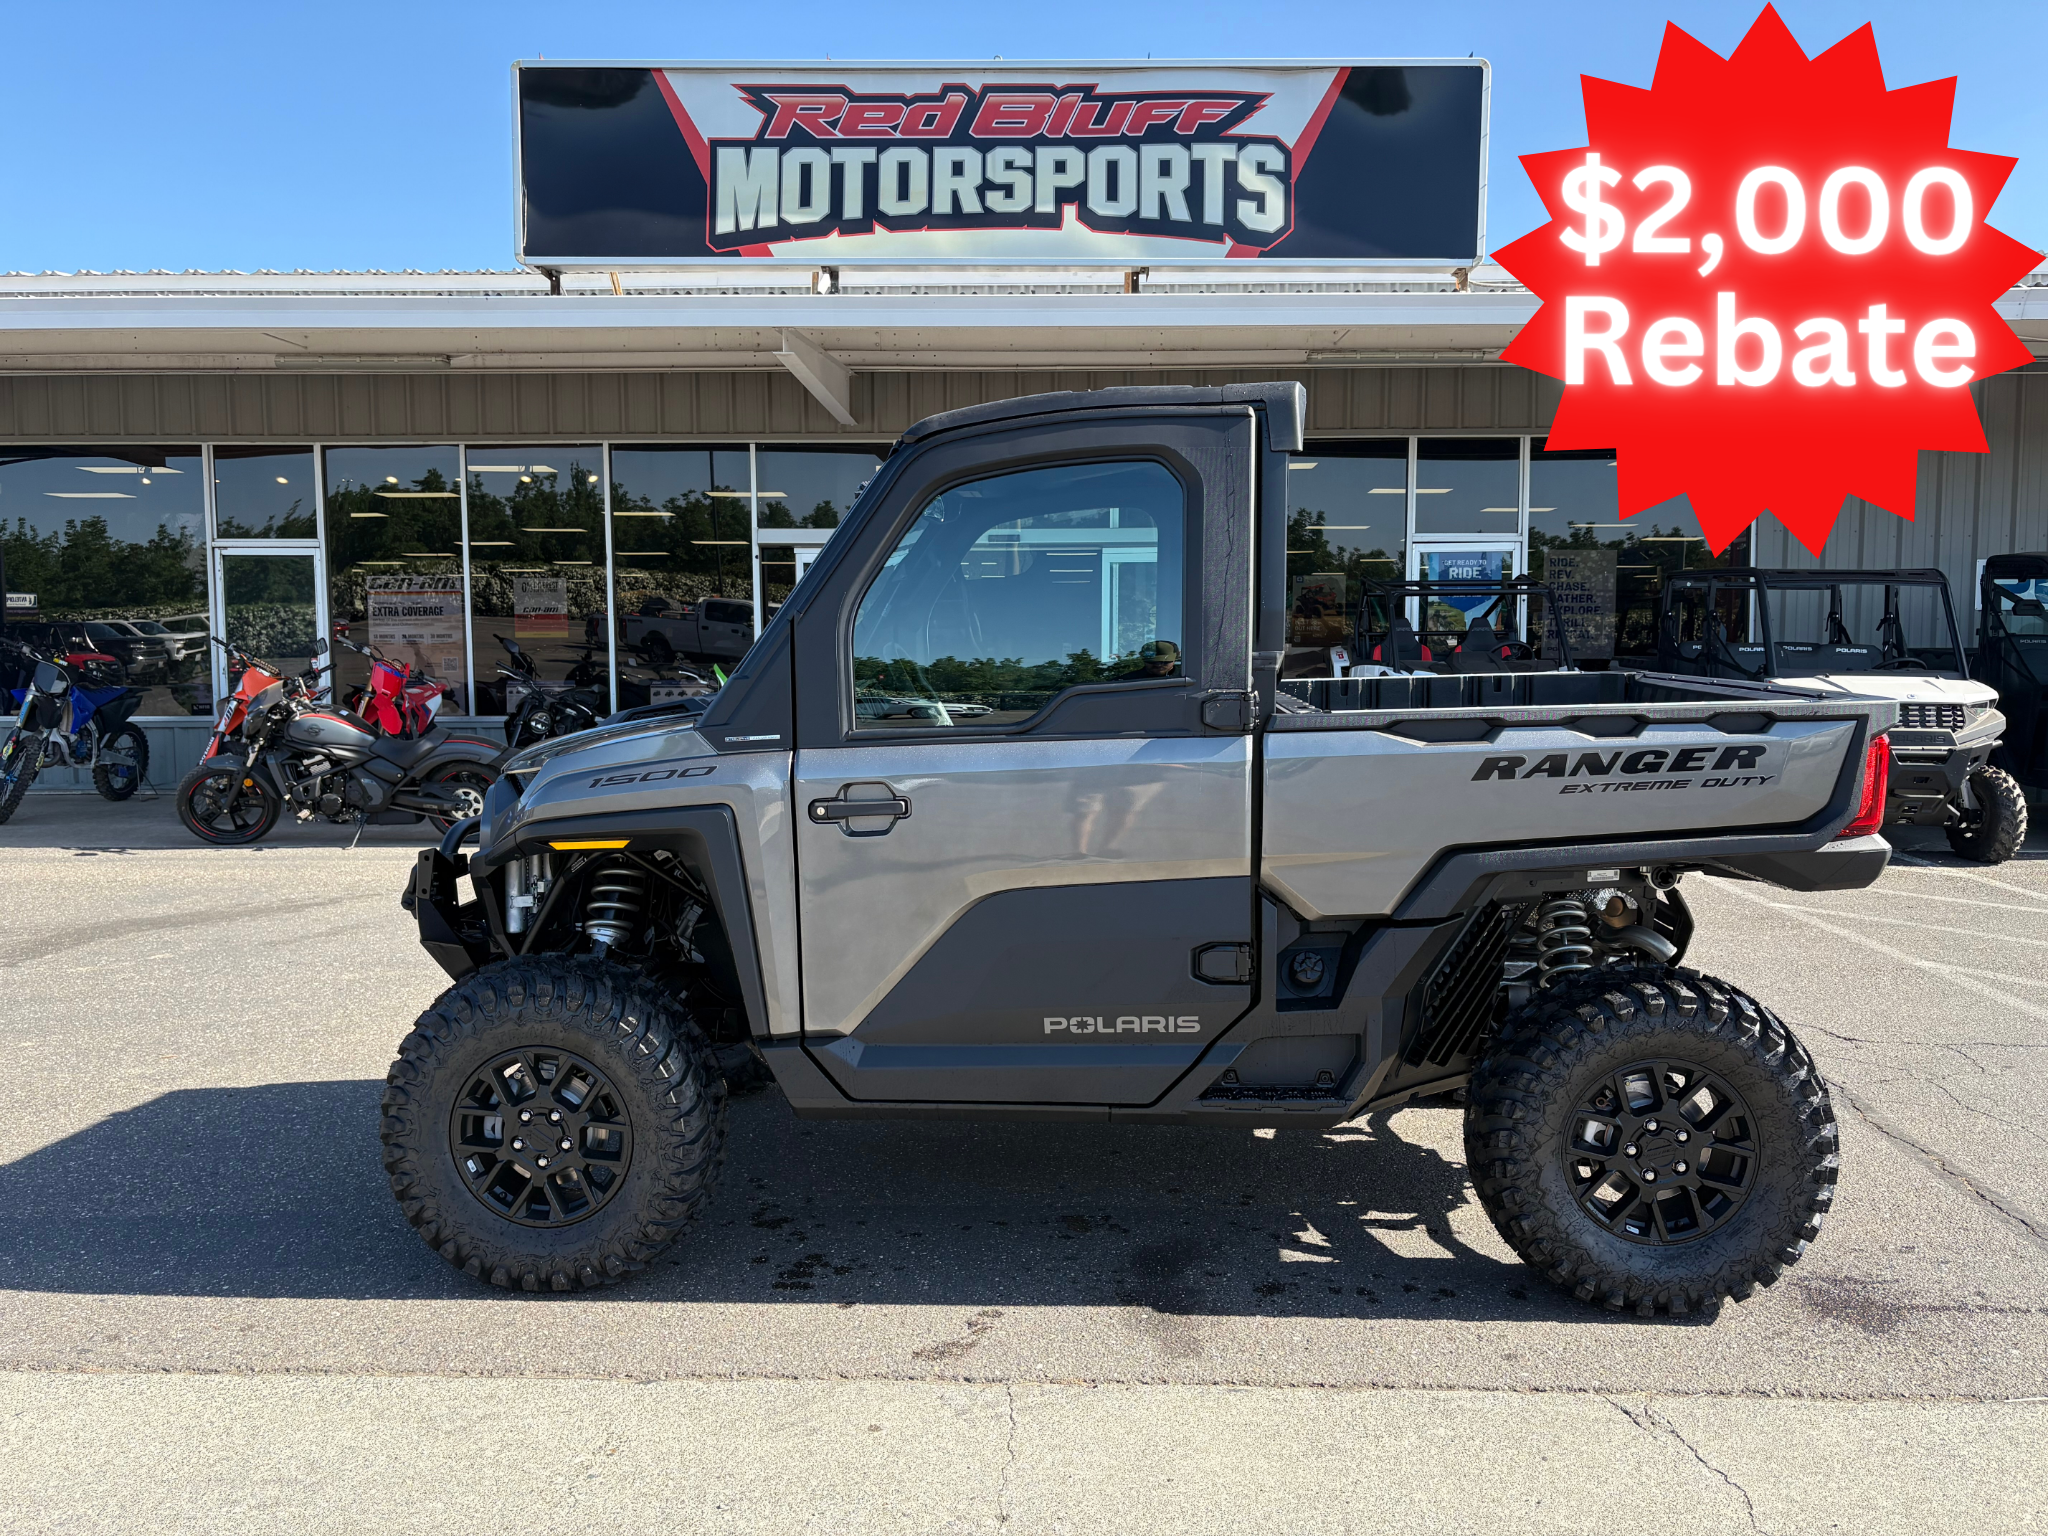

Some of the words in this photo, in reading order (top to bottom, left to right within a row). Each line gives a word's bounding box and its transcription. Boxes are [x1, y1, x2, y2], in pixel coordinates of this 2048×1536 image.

[761, 92, 967, 139] Red
[714, 143, 1286, 236] MOTORSPORTS
[1549, 557, 1579, 568] RIDE.
[1448, 566, 1482, 579] RIDE
[1549, 569, 1575, 580] REV.
[1548, 581, 1590, 592] CHASE.
[1556, 593, 1597, 604] ATHER.
[372, 606, 399, 617] EXTRA
[401, 606, 445, 617] COVERAGE
[1470, 744, 1768, 781] RANGER
[588, 765, 718, 789] 1500
[1558, 778, 1694, 795] EXTREME
[1699, 774, 1776, 788] DUTY
[1043, 1015, 1201, 1034] POLARIS
